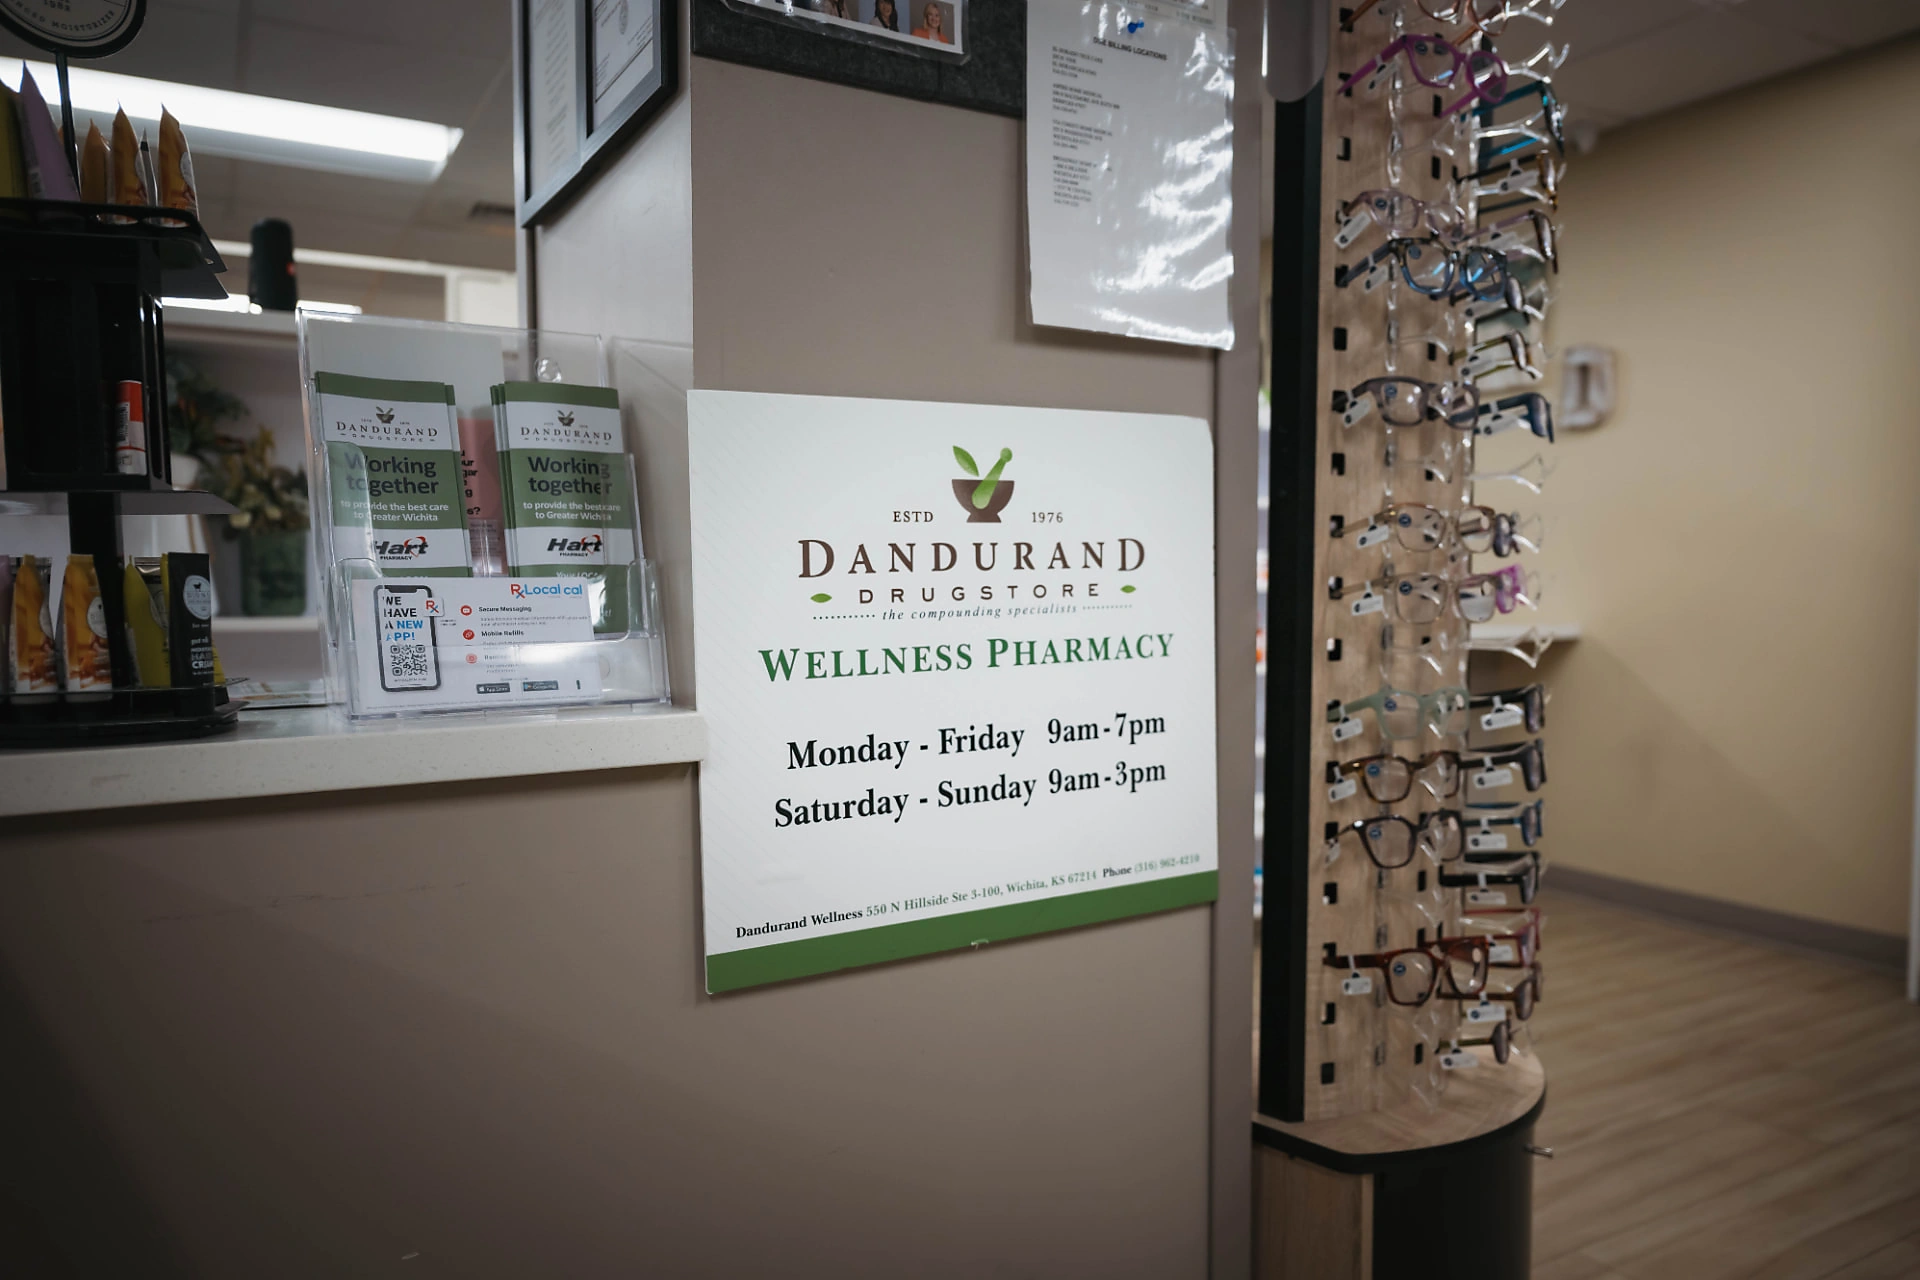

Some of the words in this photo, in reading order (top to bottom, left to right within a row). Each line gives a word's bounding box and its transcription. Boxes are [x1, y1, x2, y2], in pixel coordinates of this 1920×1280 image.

[1108, 40, 1132, 53] BILLING
[1133, 47, 1168, 61] LOCATIONS
[336, 421, 438, 438] DANDURAND
[521, 426, 612, 441] DANDURAND
[344, 452, 437, 478] Working
[528, 456, 611, 479] Working
[346, 475, 439, 497] together
[528, 477, 612, 496] together
[390, 502, 405, 511] the
[407, 502, 427, 511] best
[523, 501, 533, 509] to
[534, 501, 567, 511] provide
[569, 501, 583, 510] the
[584, 502, 601, 511] best
[535, 511, 545, 519] to
[546, 511, 579, 520] Greater
[402, 513, 439, 521] Wichita
[893, 511, 934, 523] ESTD
[1031, 511, 1064, 524] 1976
[547, 537, 602, 552] Hart
[798, 537, 1146, 578] DANDURAND
[859, 583, 1100, 604] DRUGSTORE
[384, 608, 417, 617] HAVE
[882, 608, 904, 621] the
[911, 605, 1002, 622] compounding
[1007, 603, 1078, 618] specialists
[396, 620, 423, 629] NEW
[386, 632, 416, 641] APP!
[759, 643, 972, 682] WELLNESS
[987, 633, 1174, 668] PHARMACY
[787, 735, 909, 769] Monday
[938, 725, 1025, 757] Friday
[1047, 713, 1166, 744] 9am-7pm
[775, 789, 909, 827] Saturday
[938, 774, 1037, 807] Sunday
[1048, 761, 1167, 793] 9am-3pm
[736, 916, 807, 938] Dandurand
[811, 909, 863, 926] Wellness
[866, 903, 887, 917] 550
[891, 902, 900, 913] N
[904, 895, 949, 911] Hillside
[952, 891, 968, 903] Ste
[971, 885, 1003, 900] 3-100,
[1006, 879, 1048, 894] Wichita,
[1051, 875, 1065, 887] KS
[1067, 870, 1096, 884] 67214
[1102, 865, 1132, 878] Phone
[1134, 861, 1158, 874] (316)
[1159, 854, 1201, 869] 962-4210
